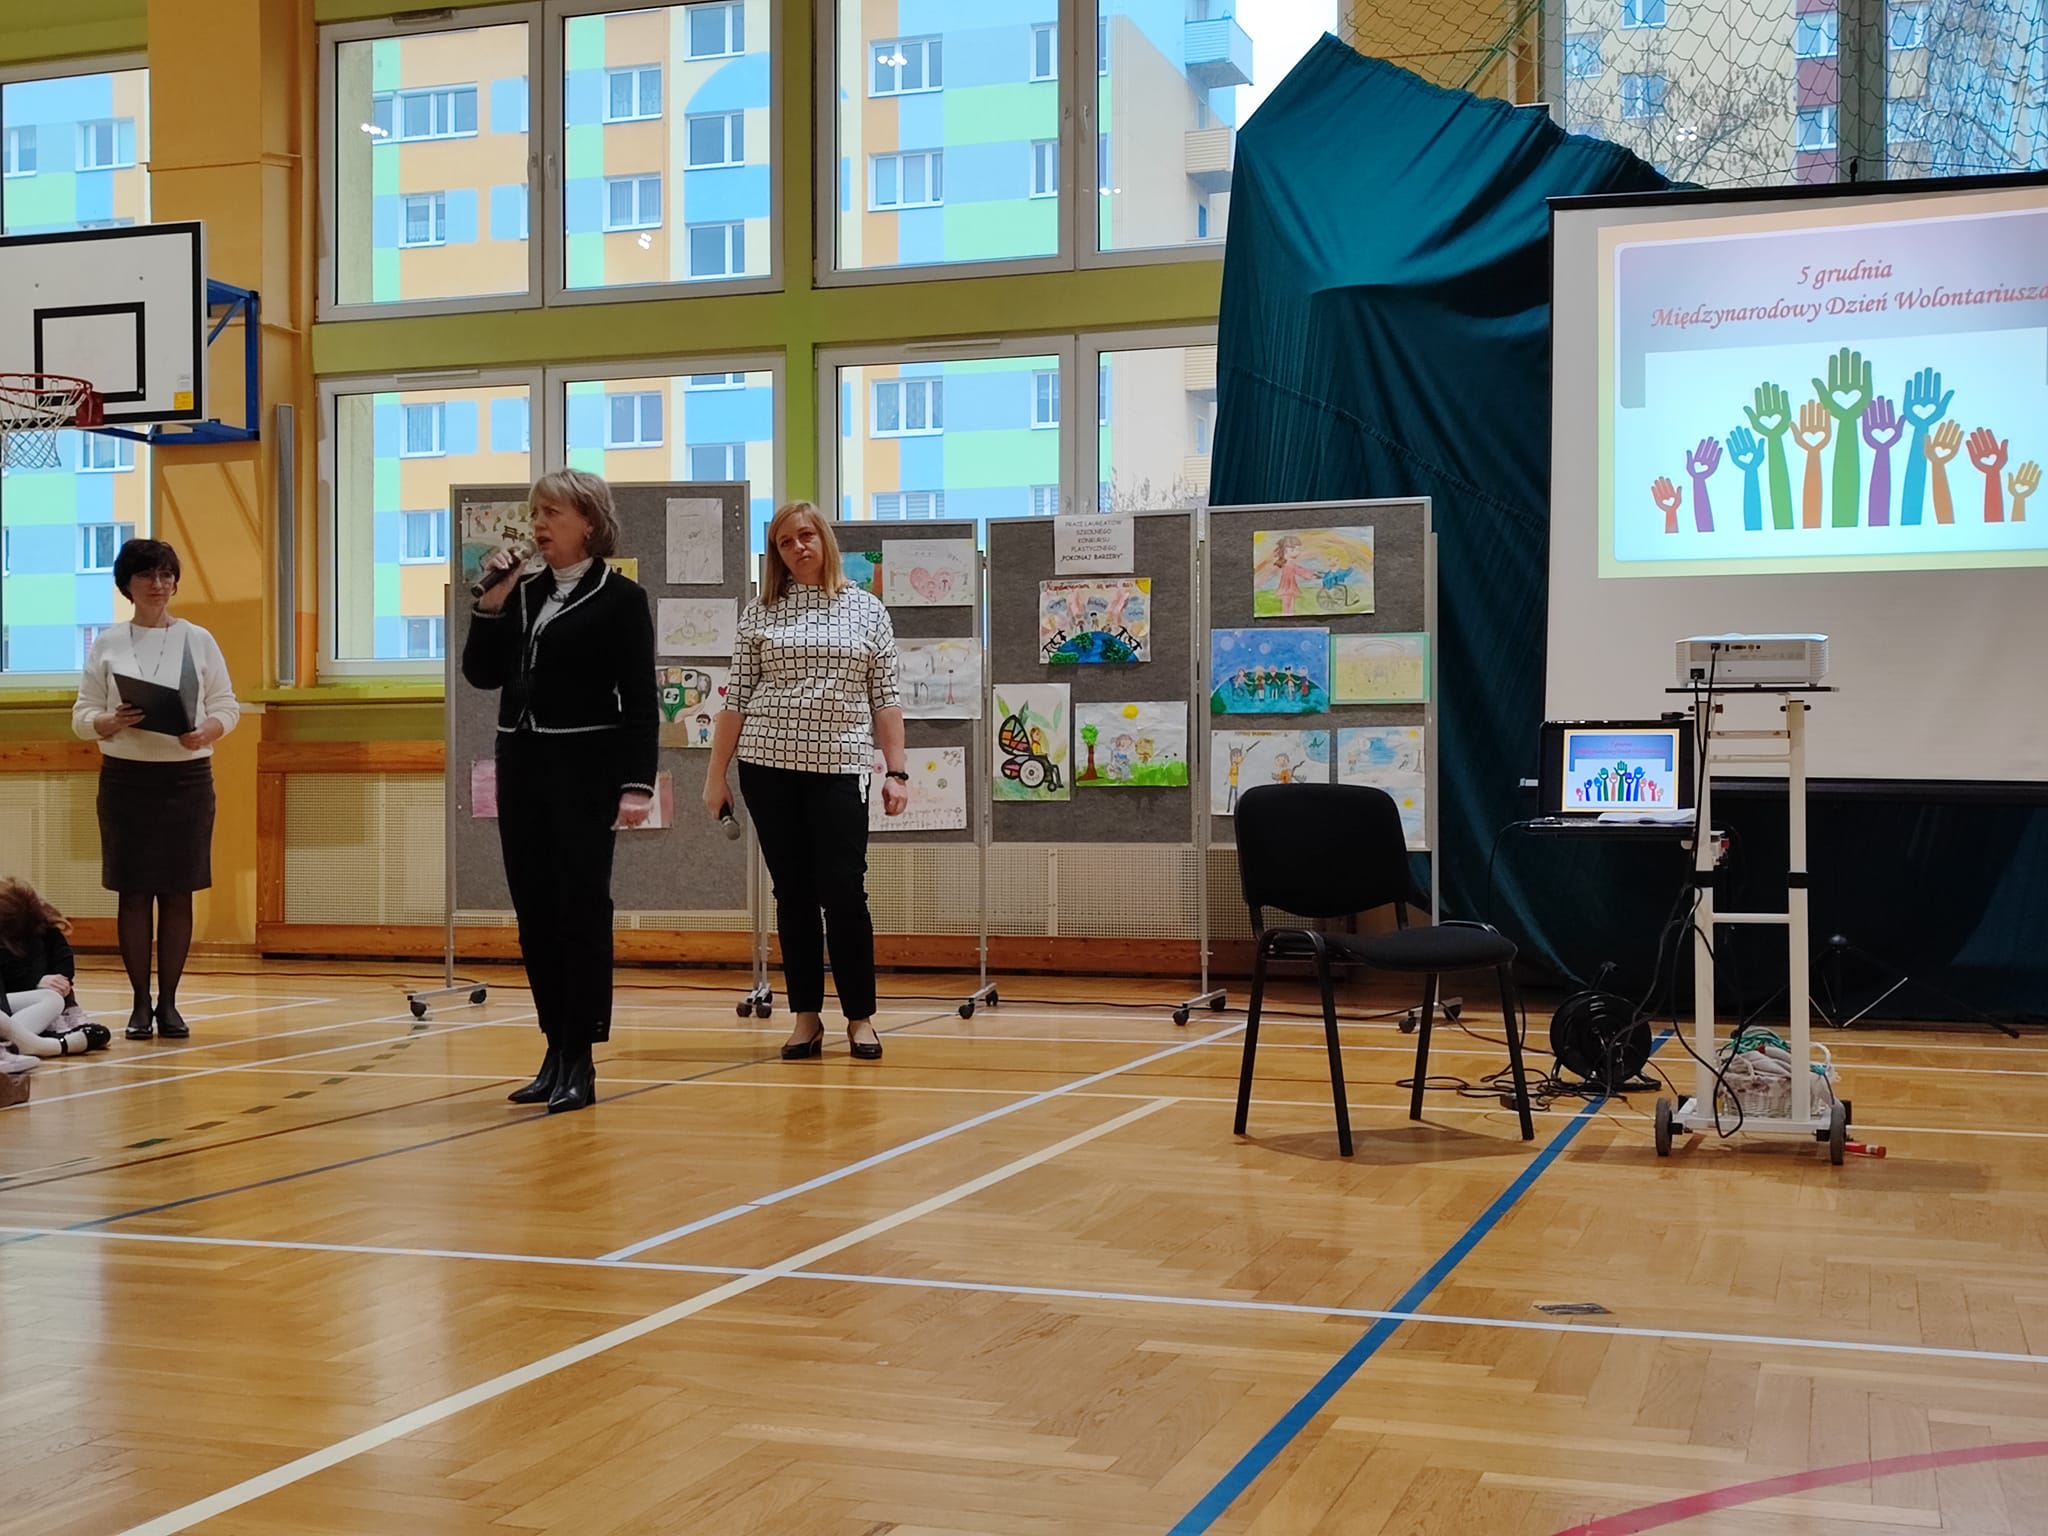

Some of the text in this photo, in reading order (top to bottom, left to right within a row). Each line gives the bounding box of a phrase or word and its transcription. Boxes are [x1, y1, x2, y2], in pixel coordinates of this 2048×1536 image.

[1797, 259, 1893, 289] 5 grudnia
[1651, 297, 1822, 330] Międzynarodowy
[1825, 295, 1889, 317] Dzień
